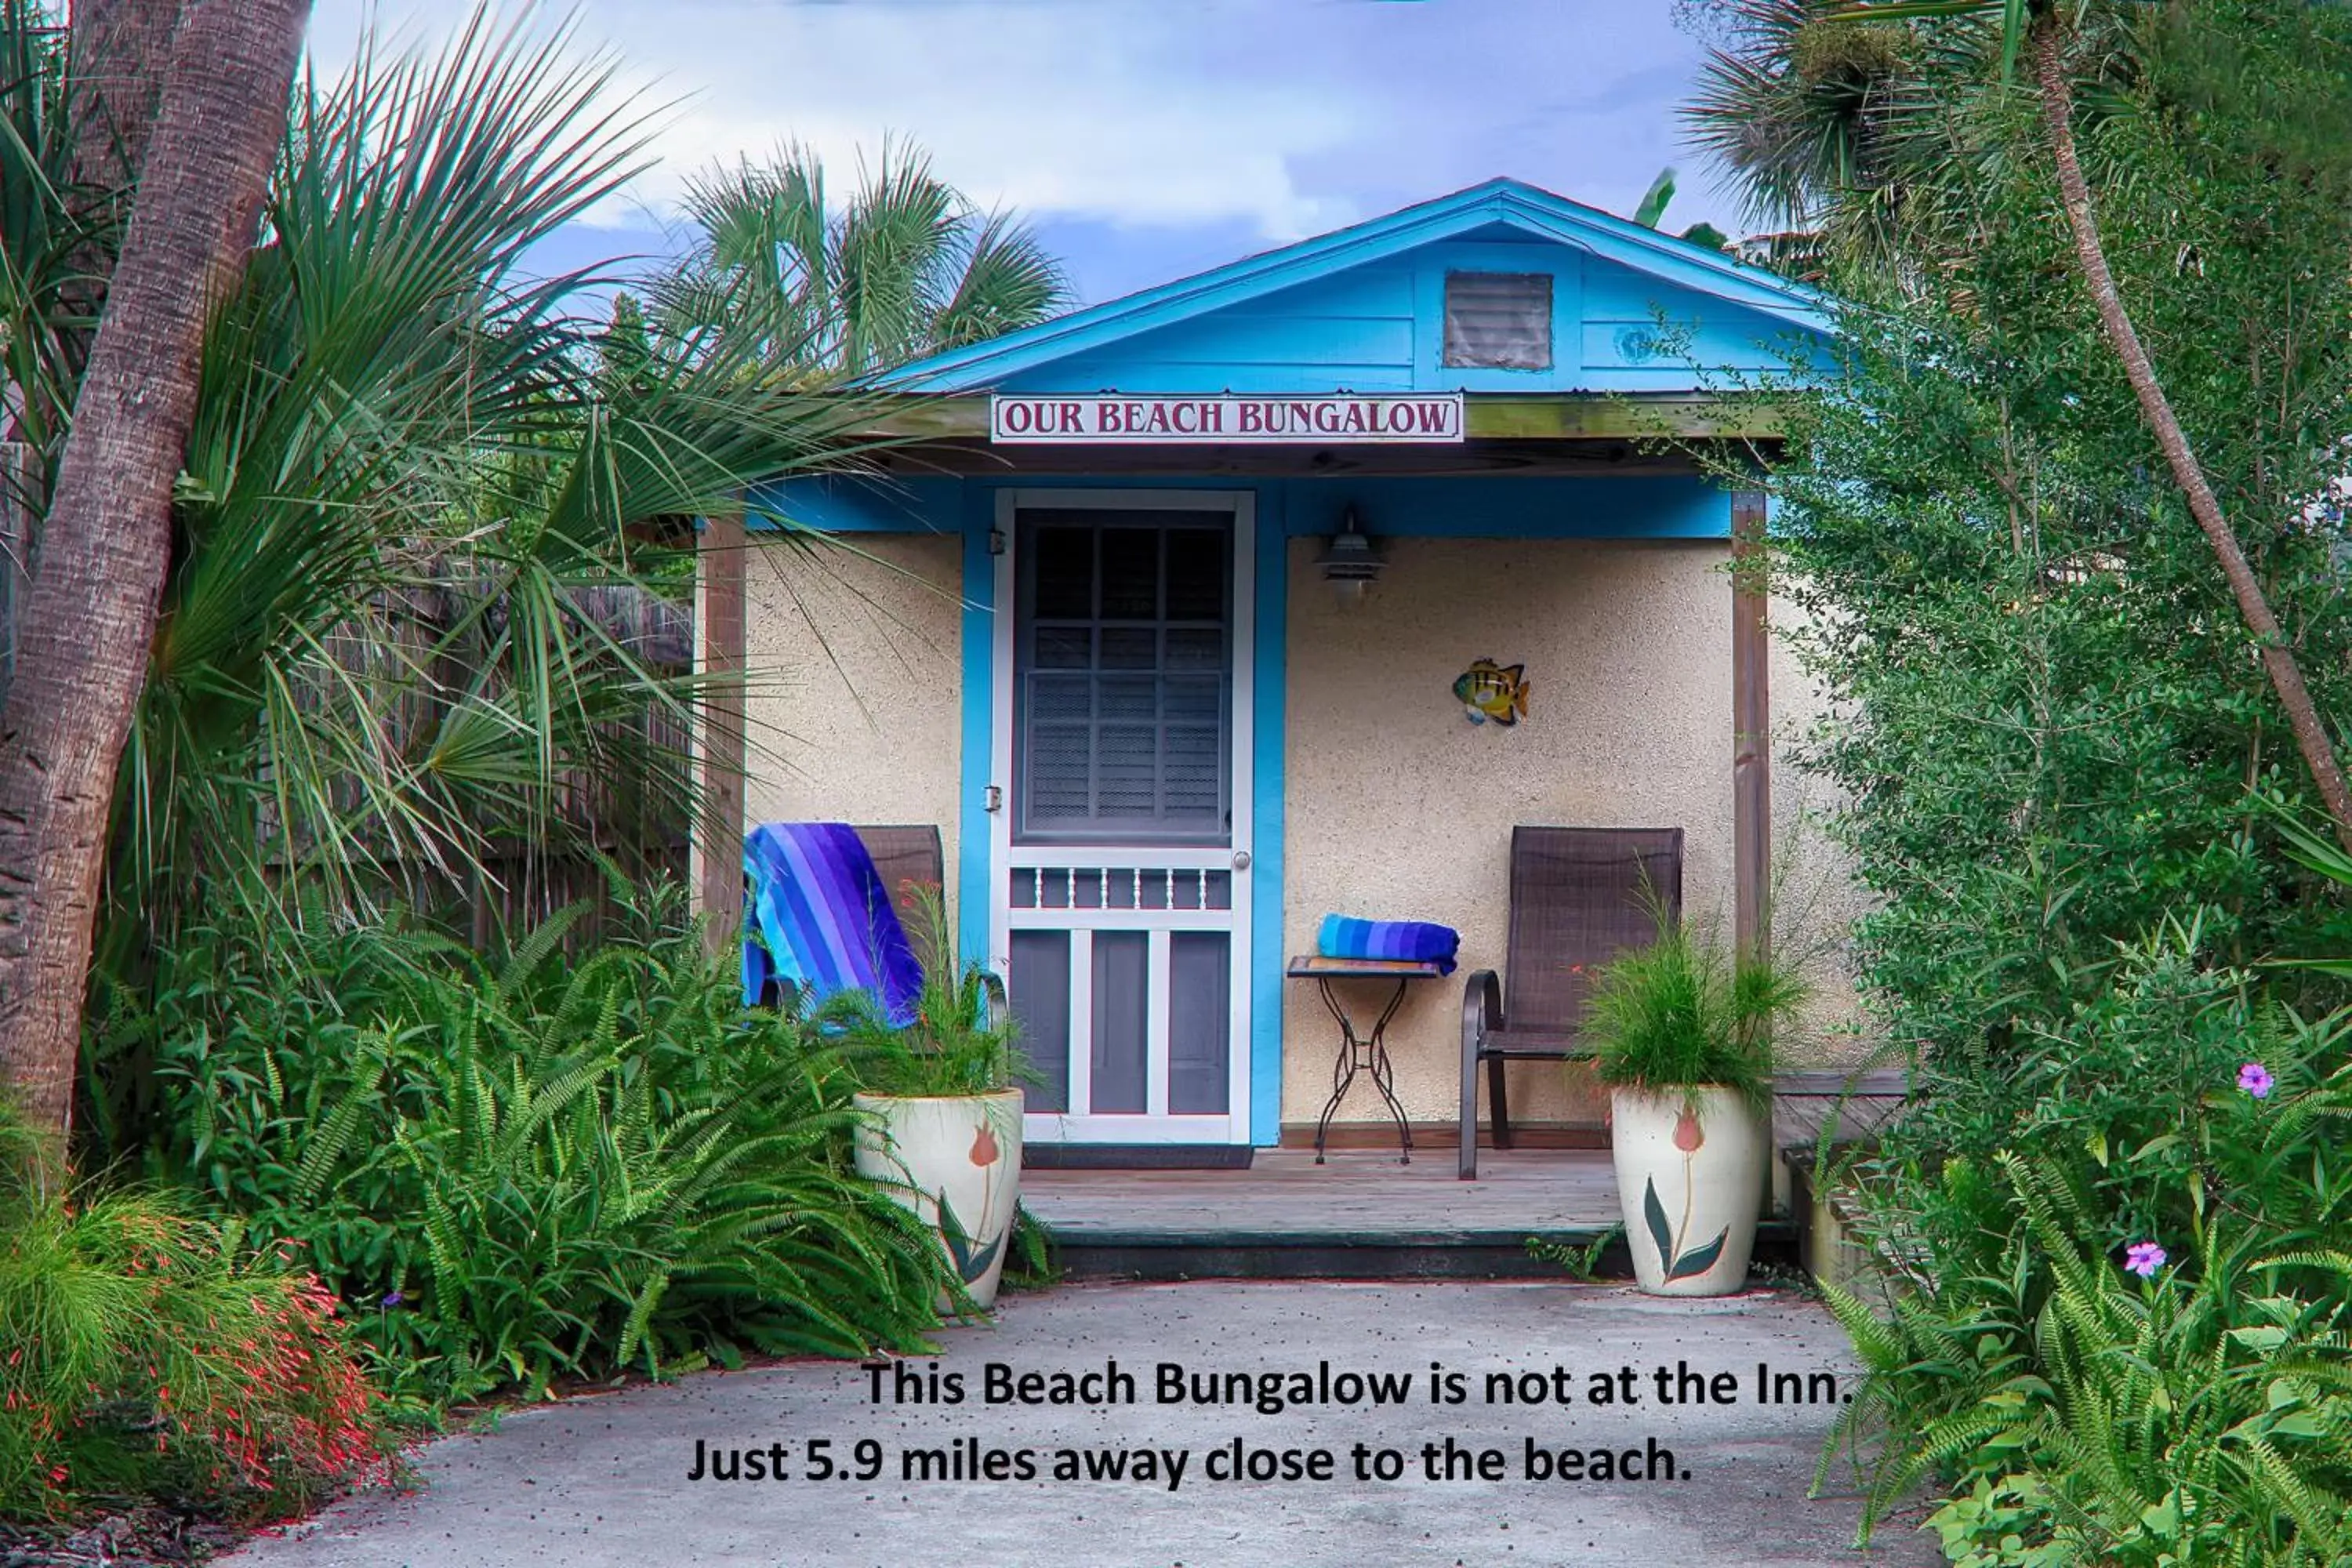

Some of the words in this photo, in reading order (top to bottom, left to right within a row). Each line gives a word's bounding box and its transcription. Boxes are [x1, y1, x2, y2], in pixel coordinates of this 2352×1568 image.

[1005, 402, 1084, 433] OUR
[1098, 402, 1223, 433] BEACH
[1238, 402, 1448, 433] BUNGALOW
